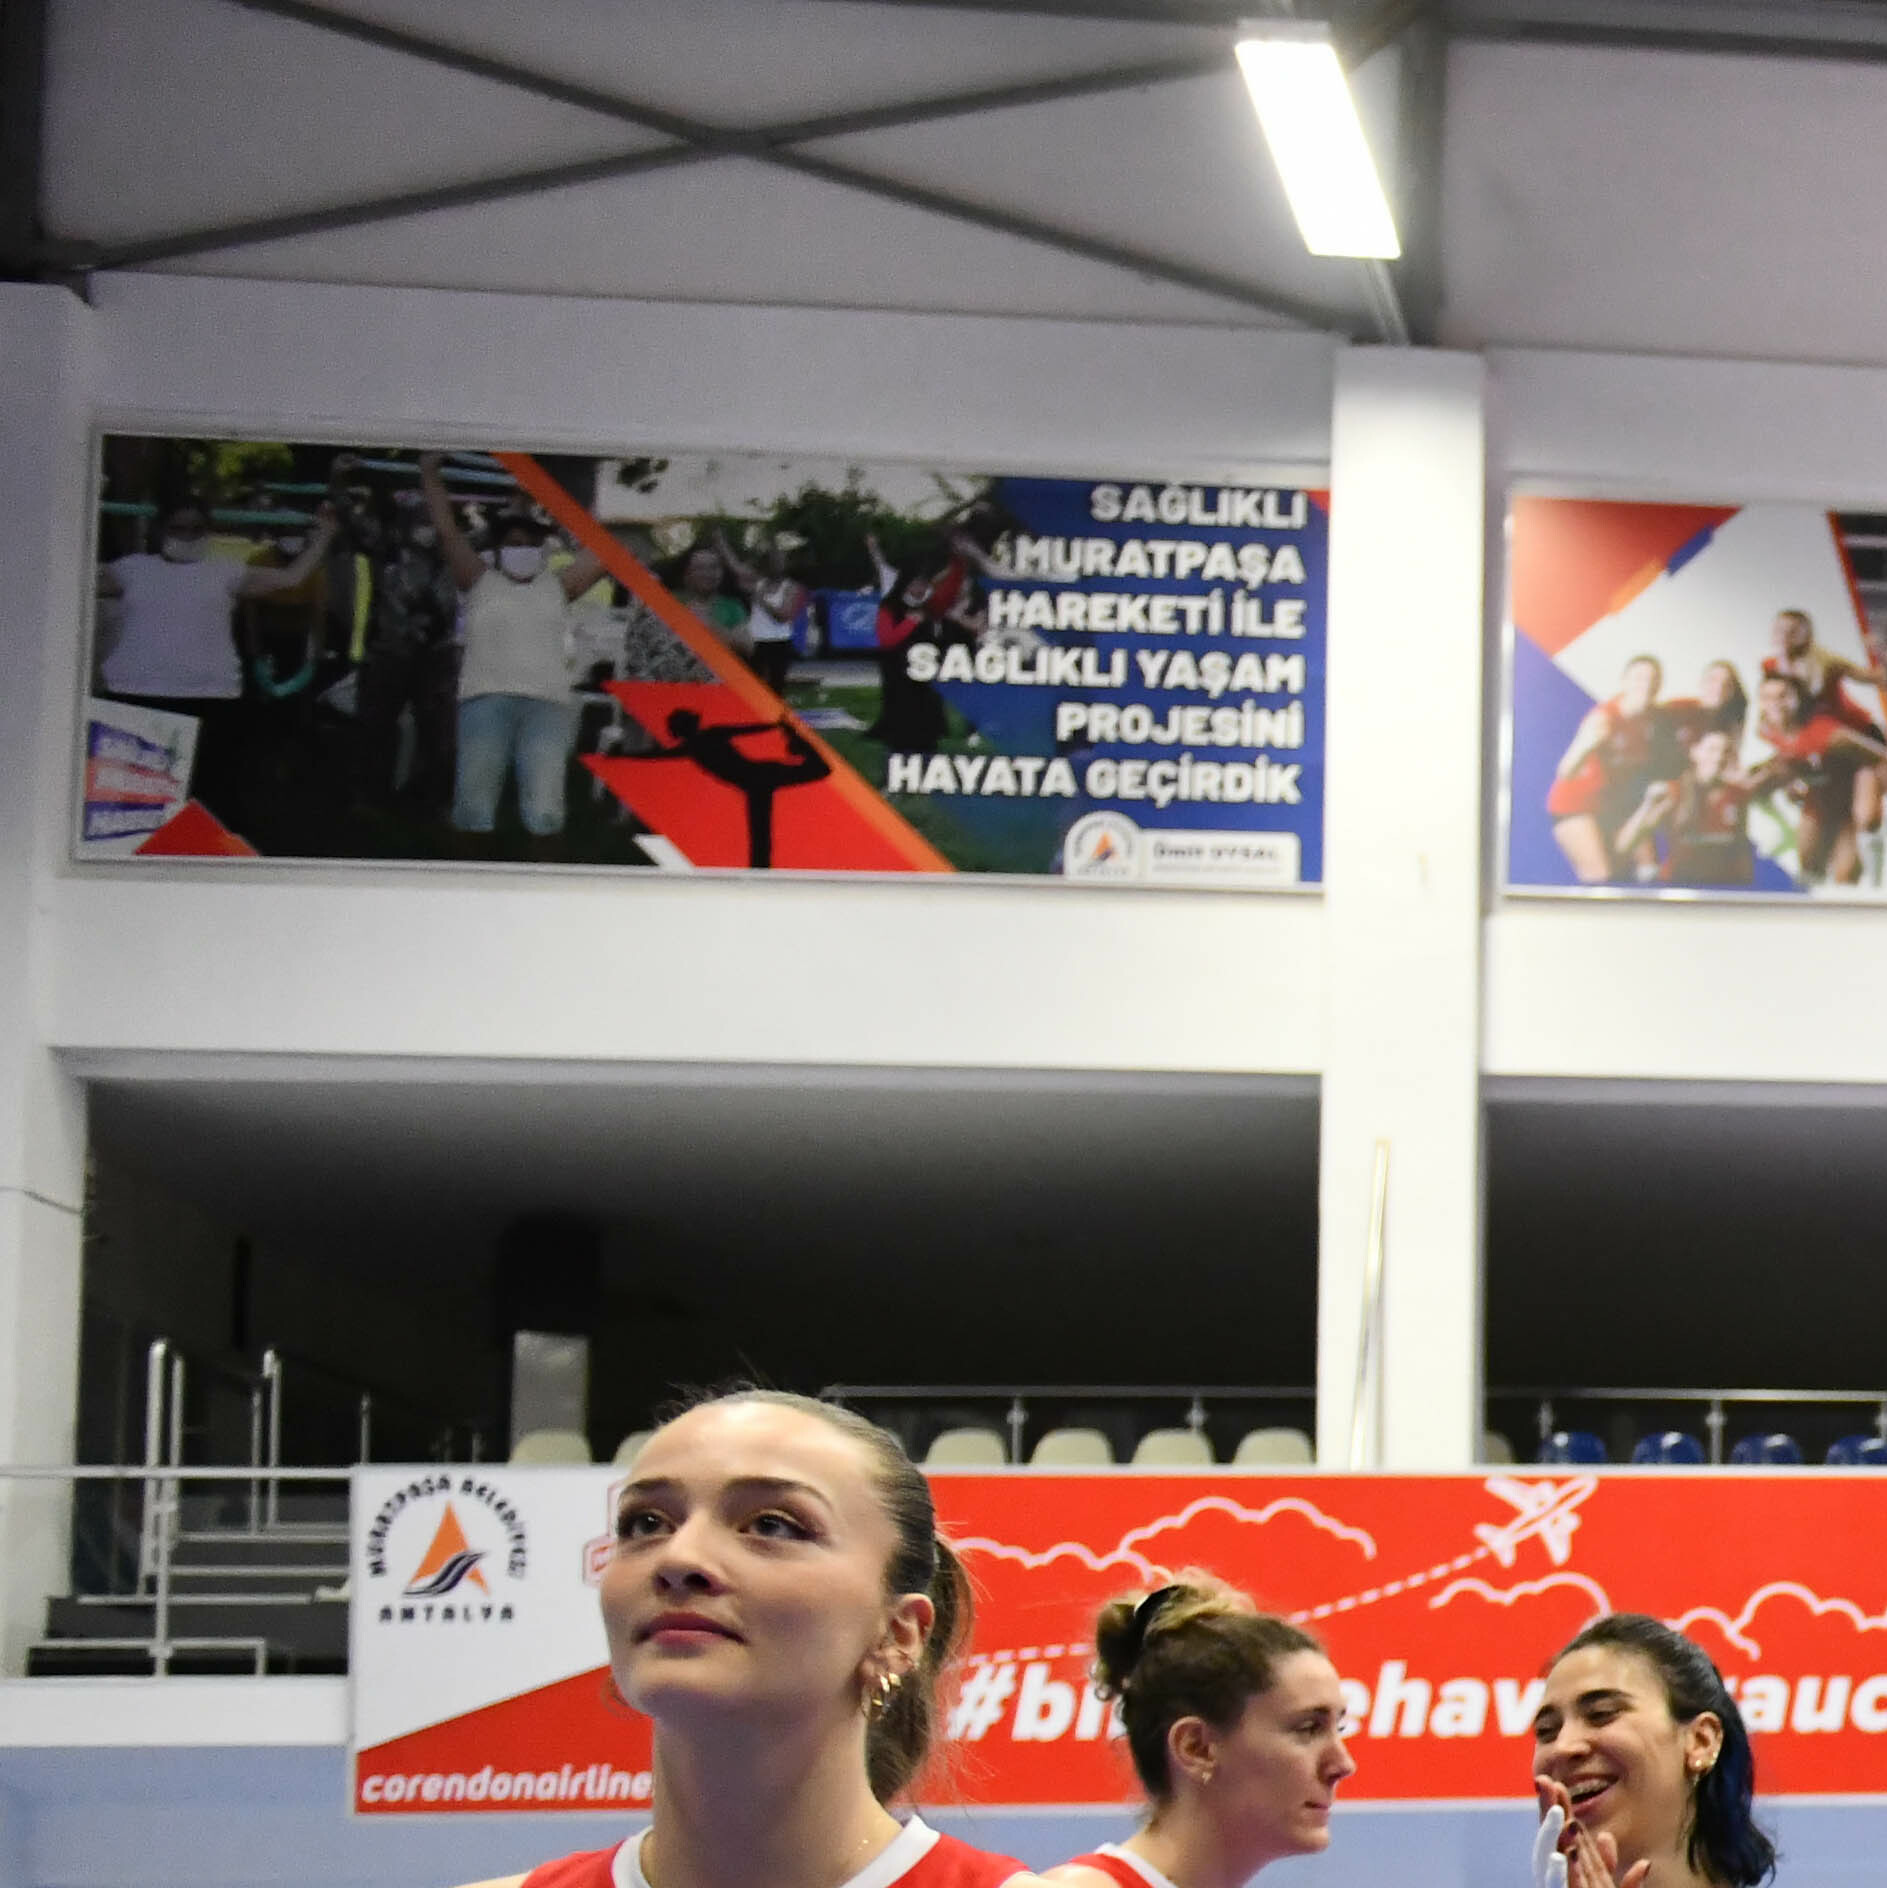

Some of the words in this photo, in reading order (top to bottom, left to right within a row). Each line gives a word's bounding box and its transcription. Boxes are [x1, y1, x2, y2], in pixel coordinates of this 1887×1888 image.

[1091, 481, 1308, 529] SAĞLIKLI
[1015, 534, 1306, 591] MURATPAŞA
[987, 587, 1225, 635] HAREKETİ
[1230, 590, 1306, 639] İLE
[907, 641, 1127, 688] SAĞLIKLI
[1137, 649, 1306, 700] YAŞAM
[1056, 699, 1305, 750] PROJESİNİ
[888, 753, 1078, 796] HAYATA
[1086, 752, 1302, 808] GEÇİRDİK
[380, 1606, 516, 1623] ANTALYA
[356, 1766, 656, 1803] corendonairline
